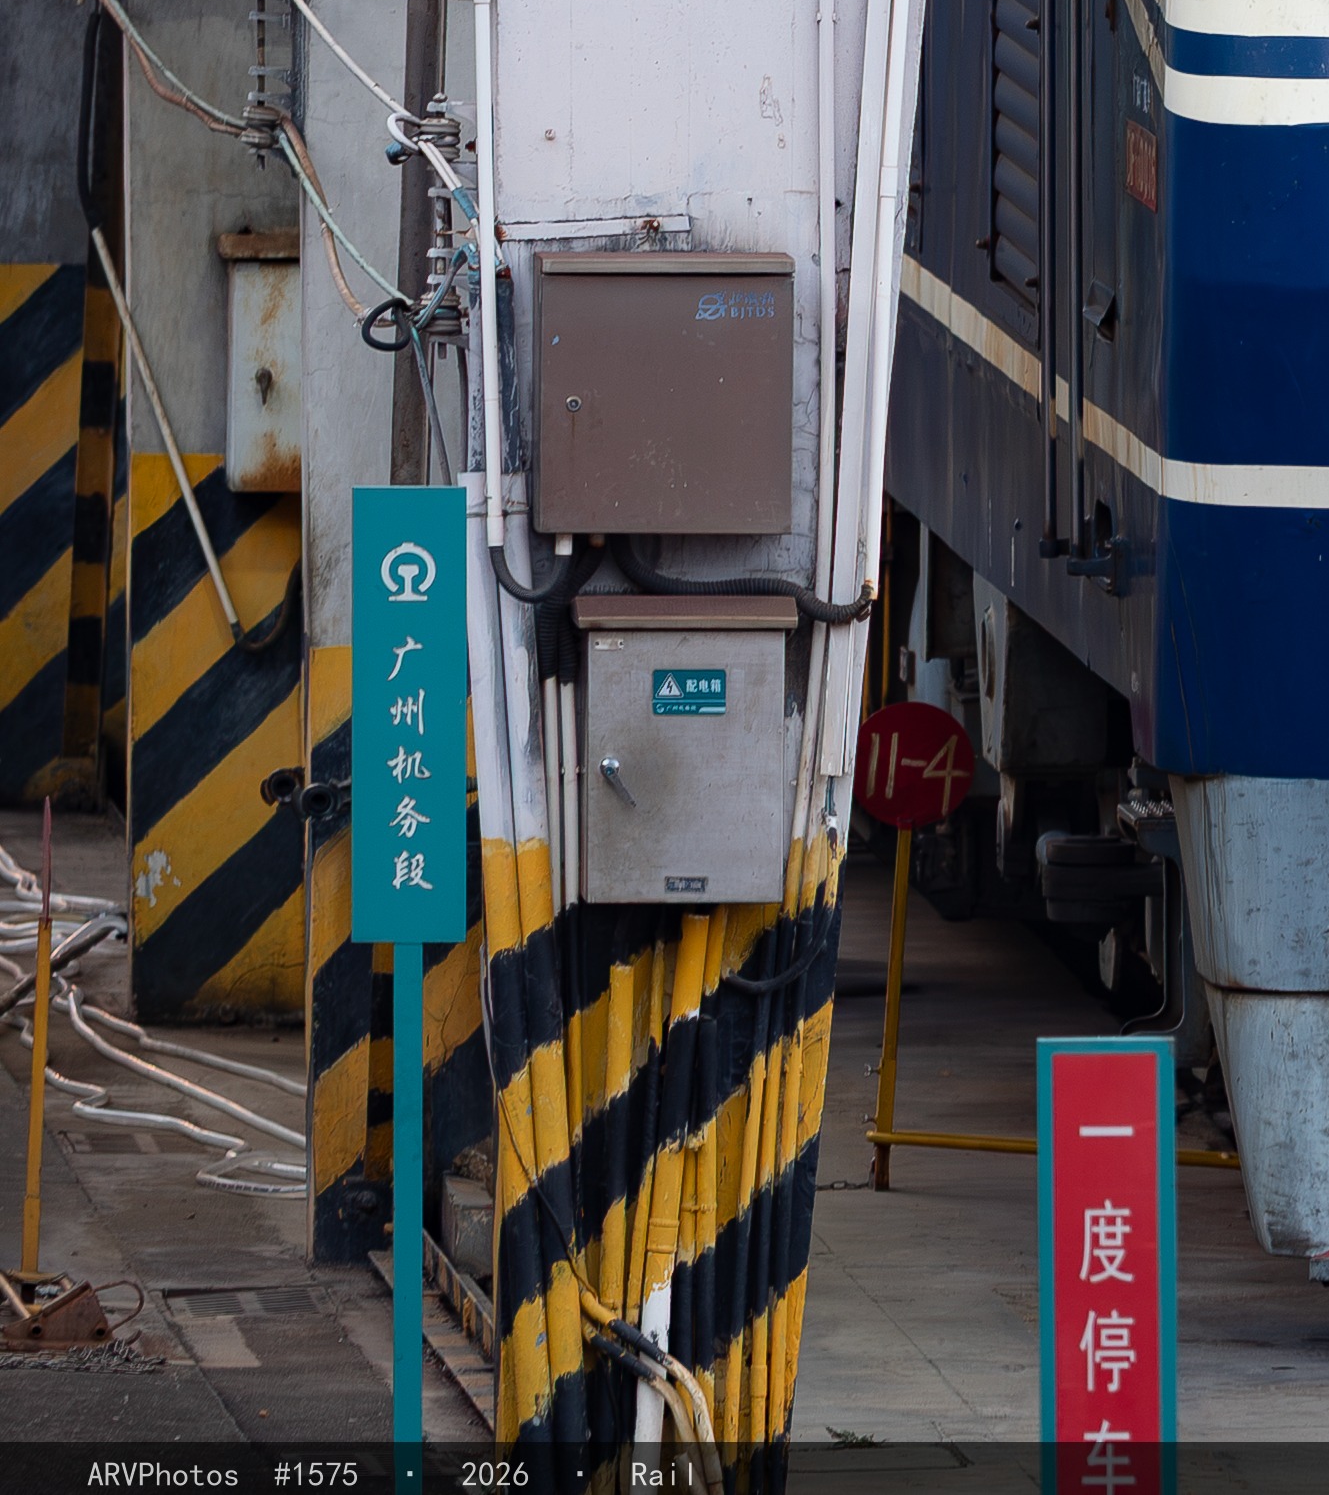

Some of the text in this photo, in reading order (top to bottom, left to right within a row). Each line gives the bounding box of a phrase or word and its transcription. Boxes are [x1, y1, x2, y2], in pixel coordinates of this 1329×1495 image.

[387, 636, 433, 891] 广州机务段
[685, 678, 722, 694] 配电箱
[866, 731, 970, 817] 11-4
[1078, 1125, 1137, 1495] 一度停车
